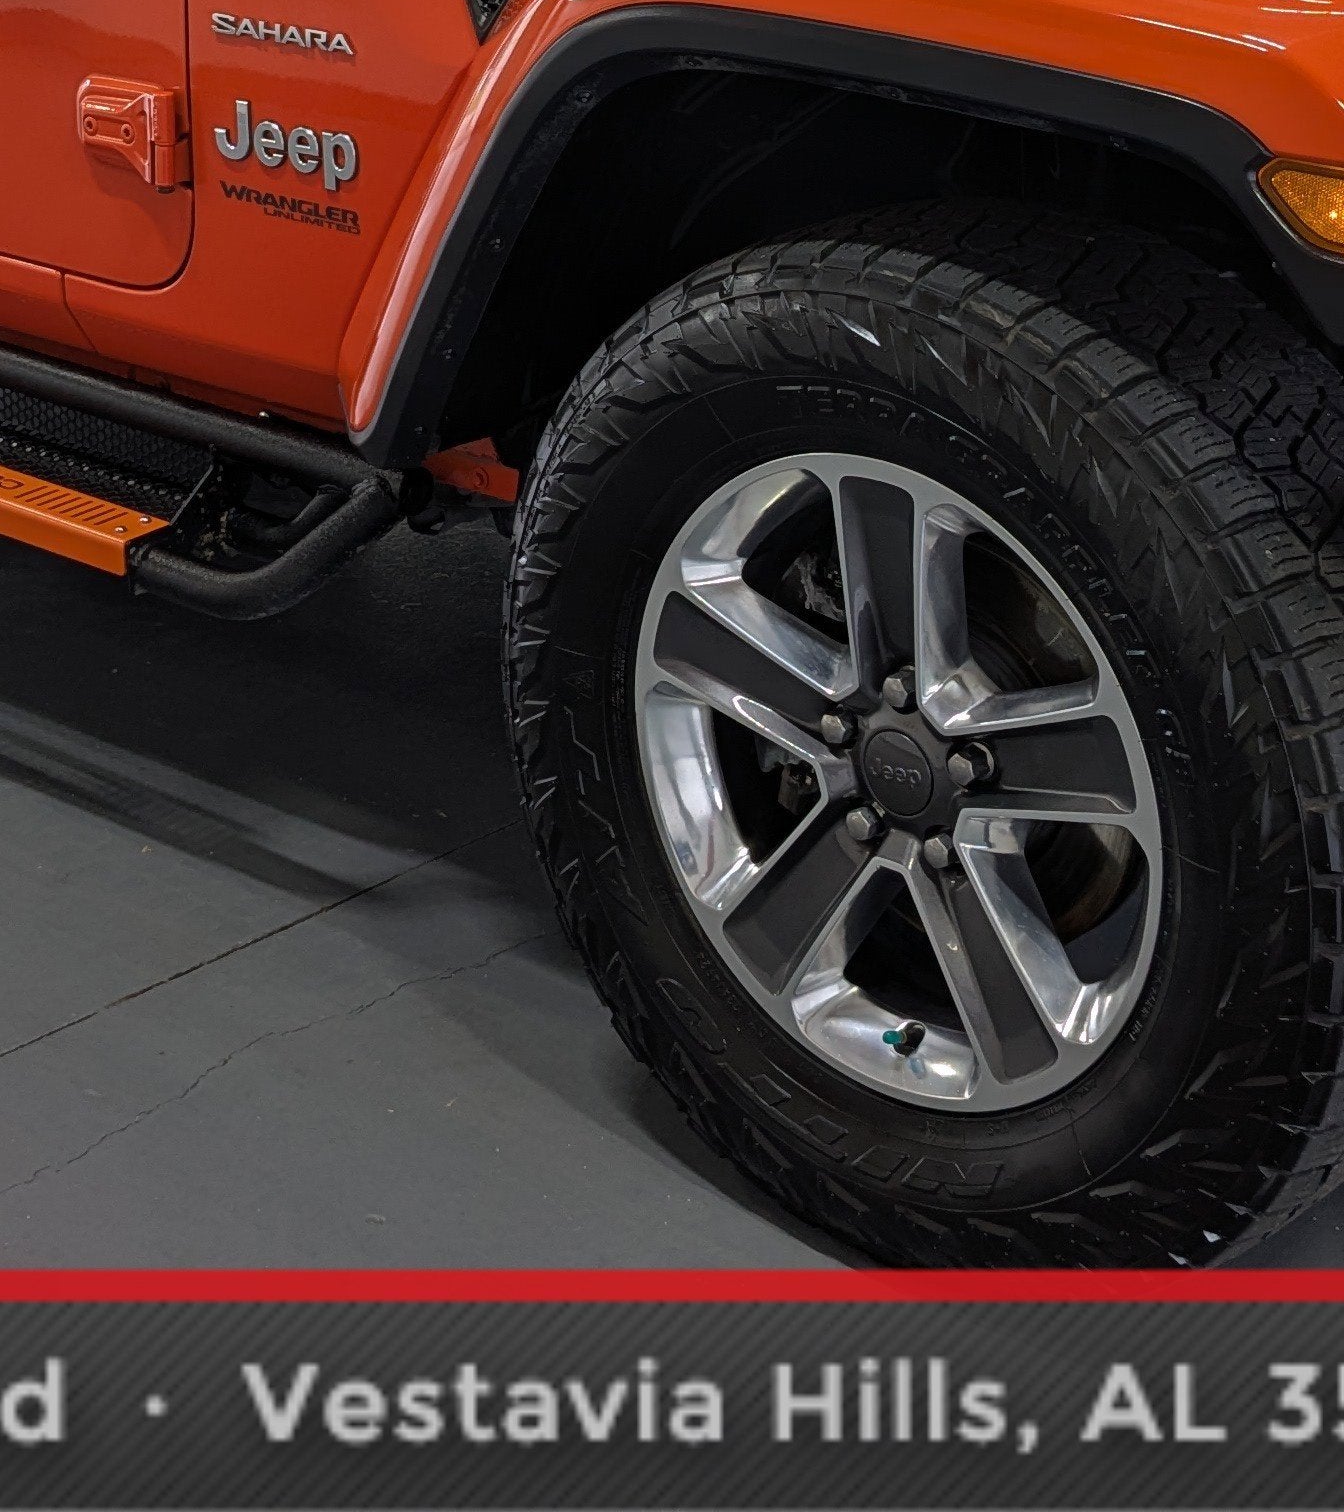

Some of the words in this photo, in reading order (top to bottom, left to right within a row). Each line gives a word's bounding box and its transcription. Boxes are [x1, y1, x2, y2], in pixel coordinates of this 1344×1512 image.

[211, 12, 354, 55] SAHARA
[214, 99, 358, 192] Jeep
[219, 179, 359, 226] WRANGLER
[263, 206, 361, 235] UNLIMITED
[868, 755, 923, 791] Jeep
